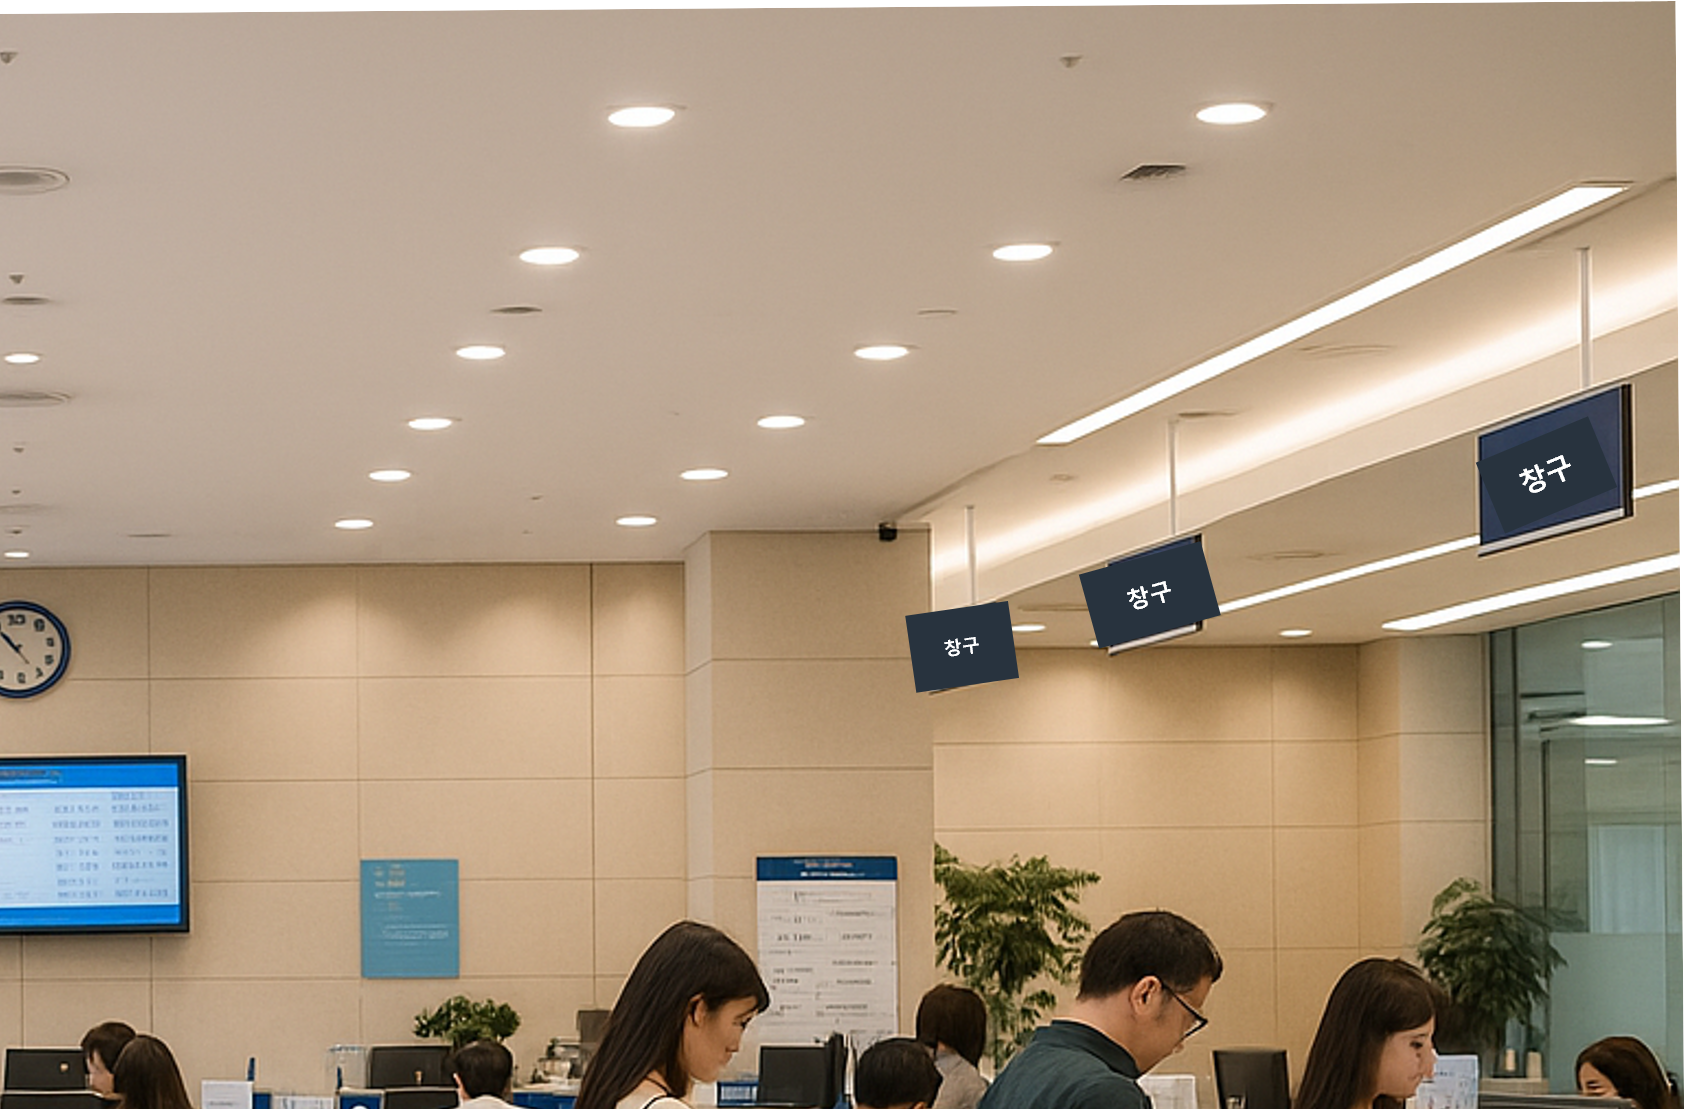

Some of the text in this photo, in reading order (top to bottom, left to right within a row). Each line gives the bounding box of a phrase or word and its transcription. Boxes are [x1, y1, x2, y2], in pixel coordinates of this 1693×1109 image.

[1518, 454, 1572, 494] 창구
[1126, 580, 1172, 611] 창구
[943, 636, 980, 658] 창구
